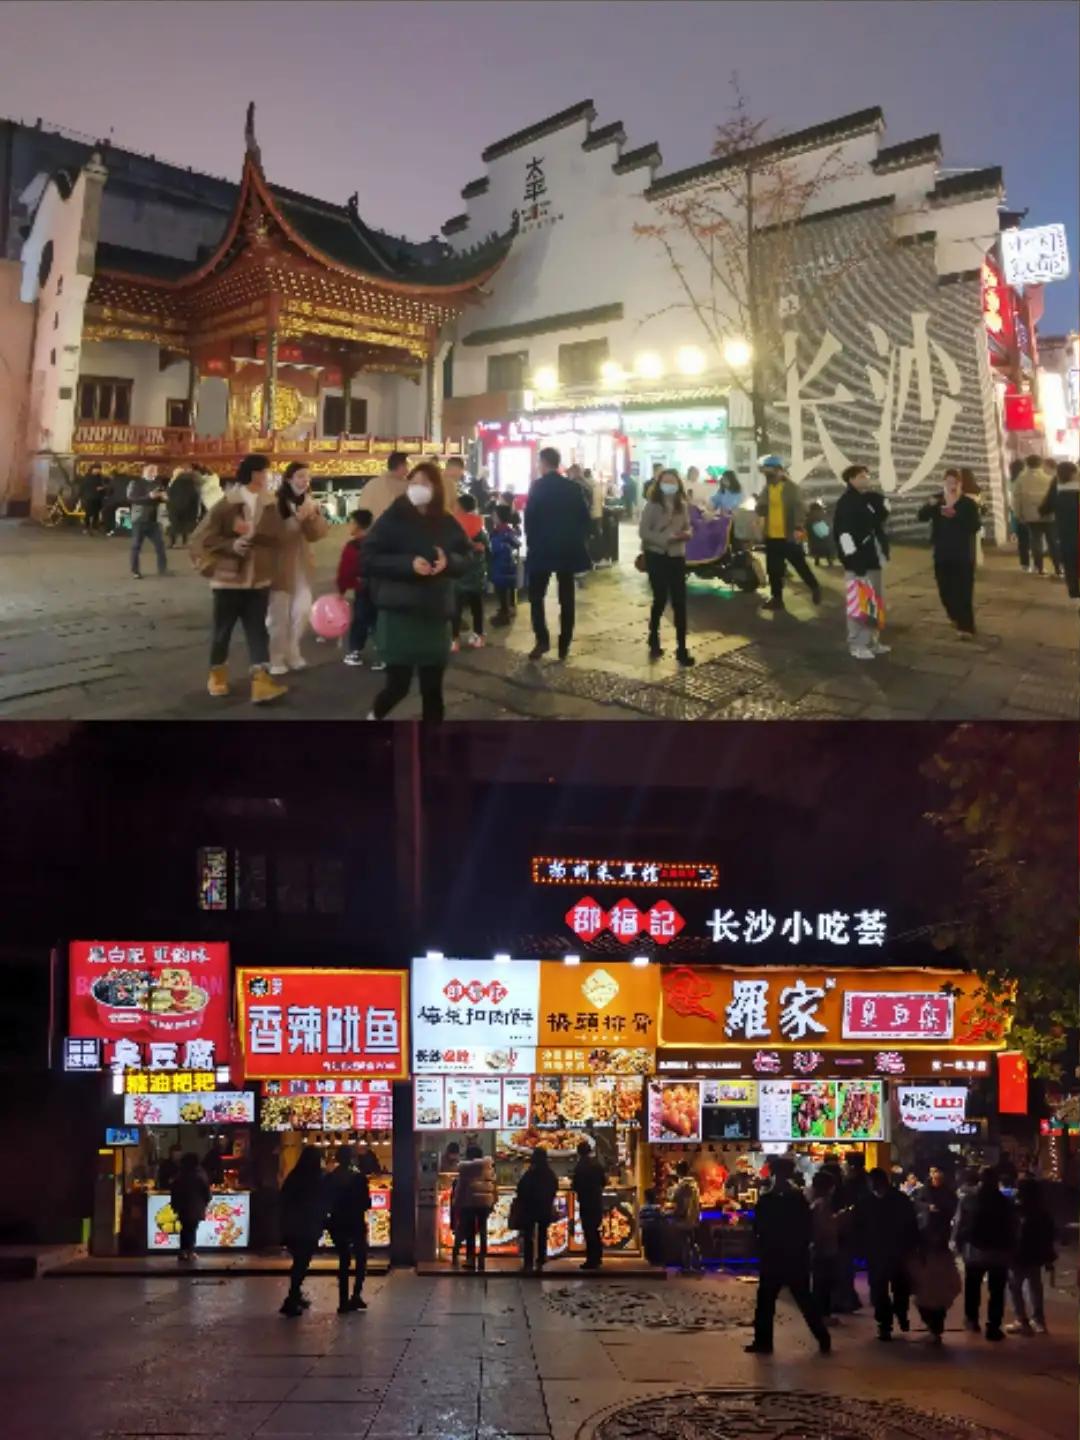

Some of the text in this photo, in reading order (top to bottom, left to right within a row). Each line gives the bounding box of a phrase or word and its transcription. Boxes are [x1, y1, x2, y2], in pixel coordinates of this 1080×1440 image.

[768, 312, 963, 493] 长沙
[706, 908, 888, 947] 长沙小吃荟
[249, 1005, 400, 1054] 香辣鱿鱼
[111, 1037, 215, 1071] 臭豆腐
